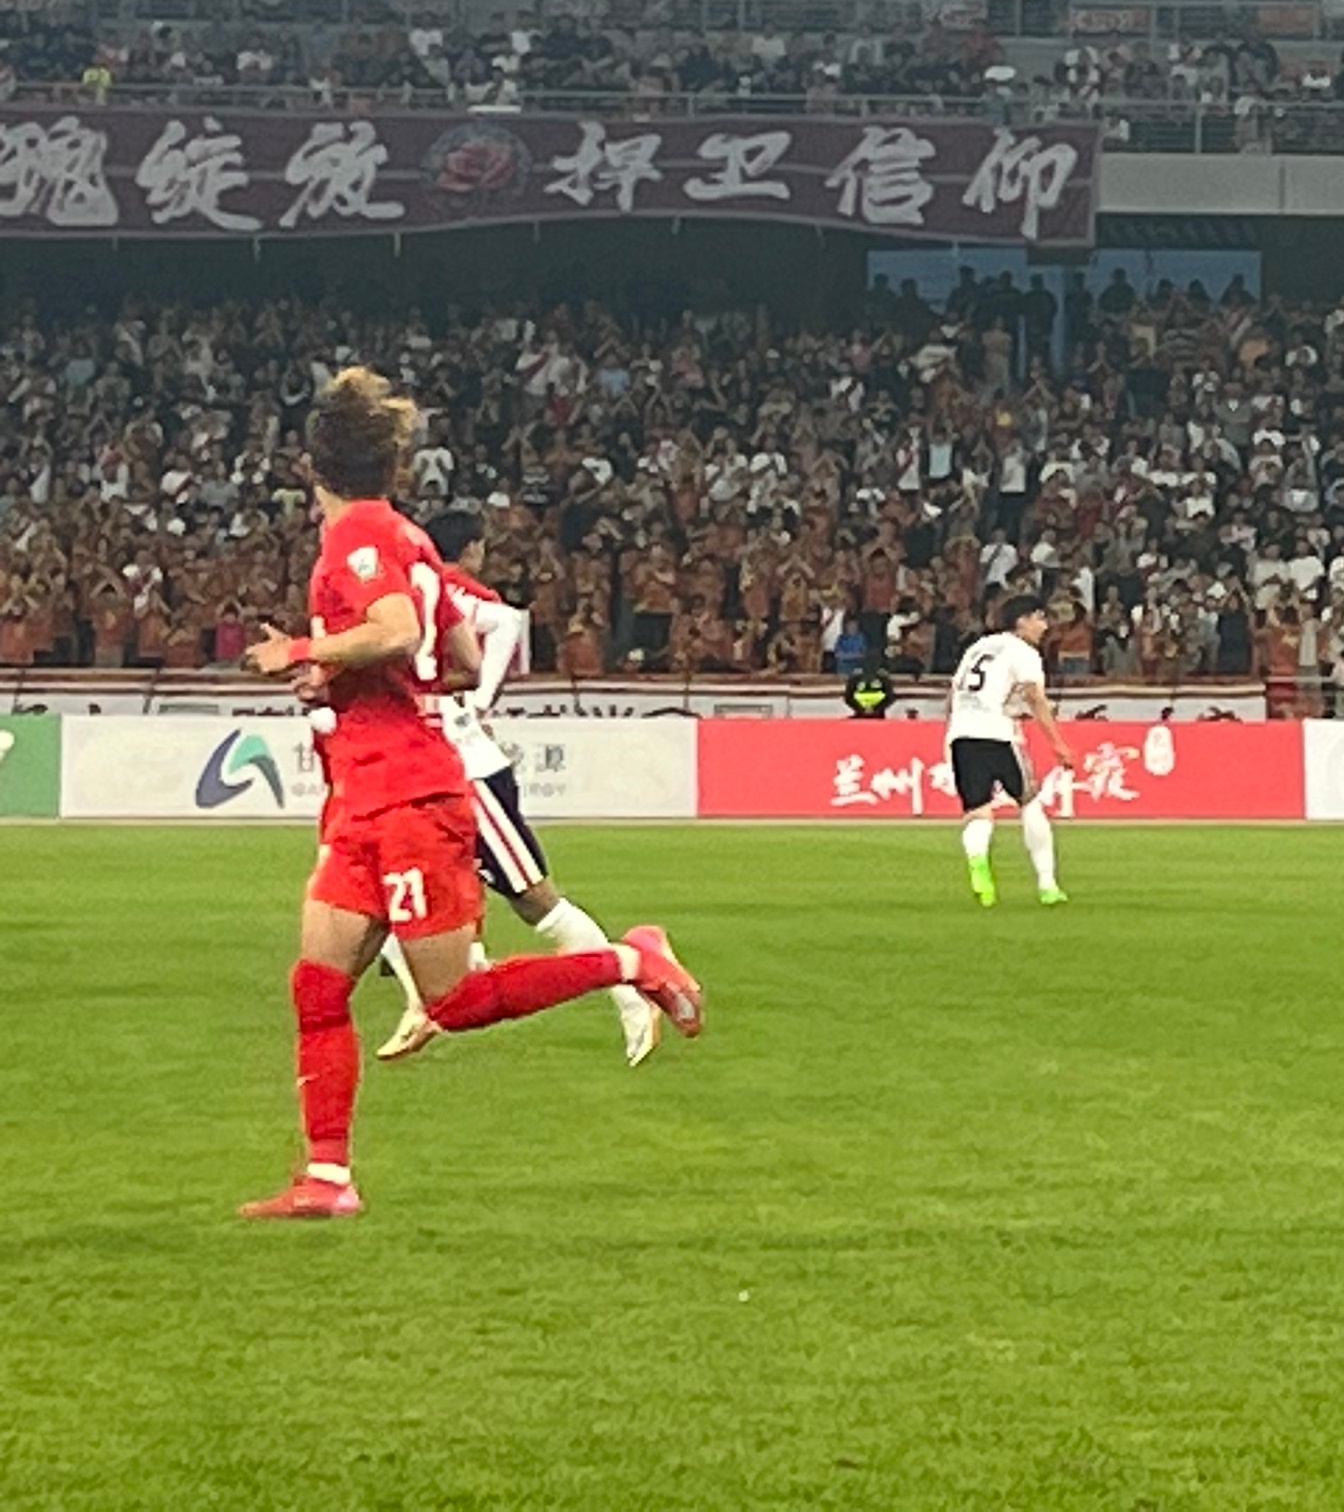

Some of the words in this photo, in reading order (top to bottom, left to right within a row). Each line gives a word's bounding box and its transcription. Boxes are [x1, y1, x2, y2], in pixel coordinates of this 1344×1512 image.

[552, 122, 1079, 240] 捍卫信仰
[382, 867, 427, 921] 21
